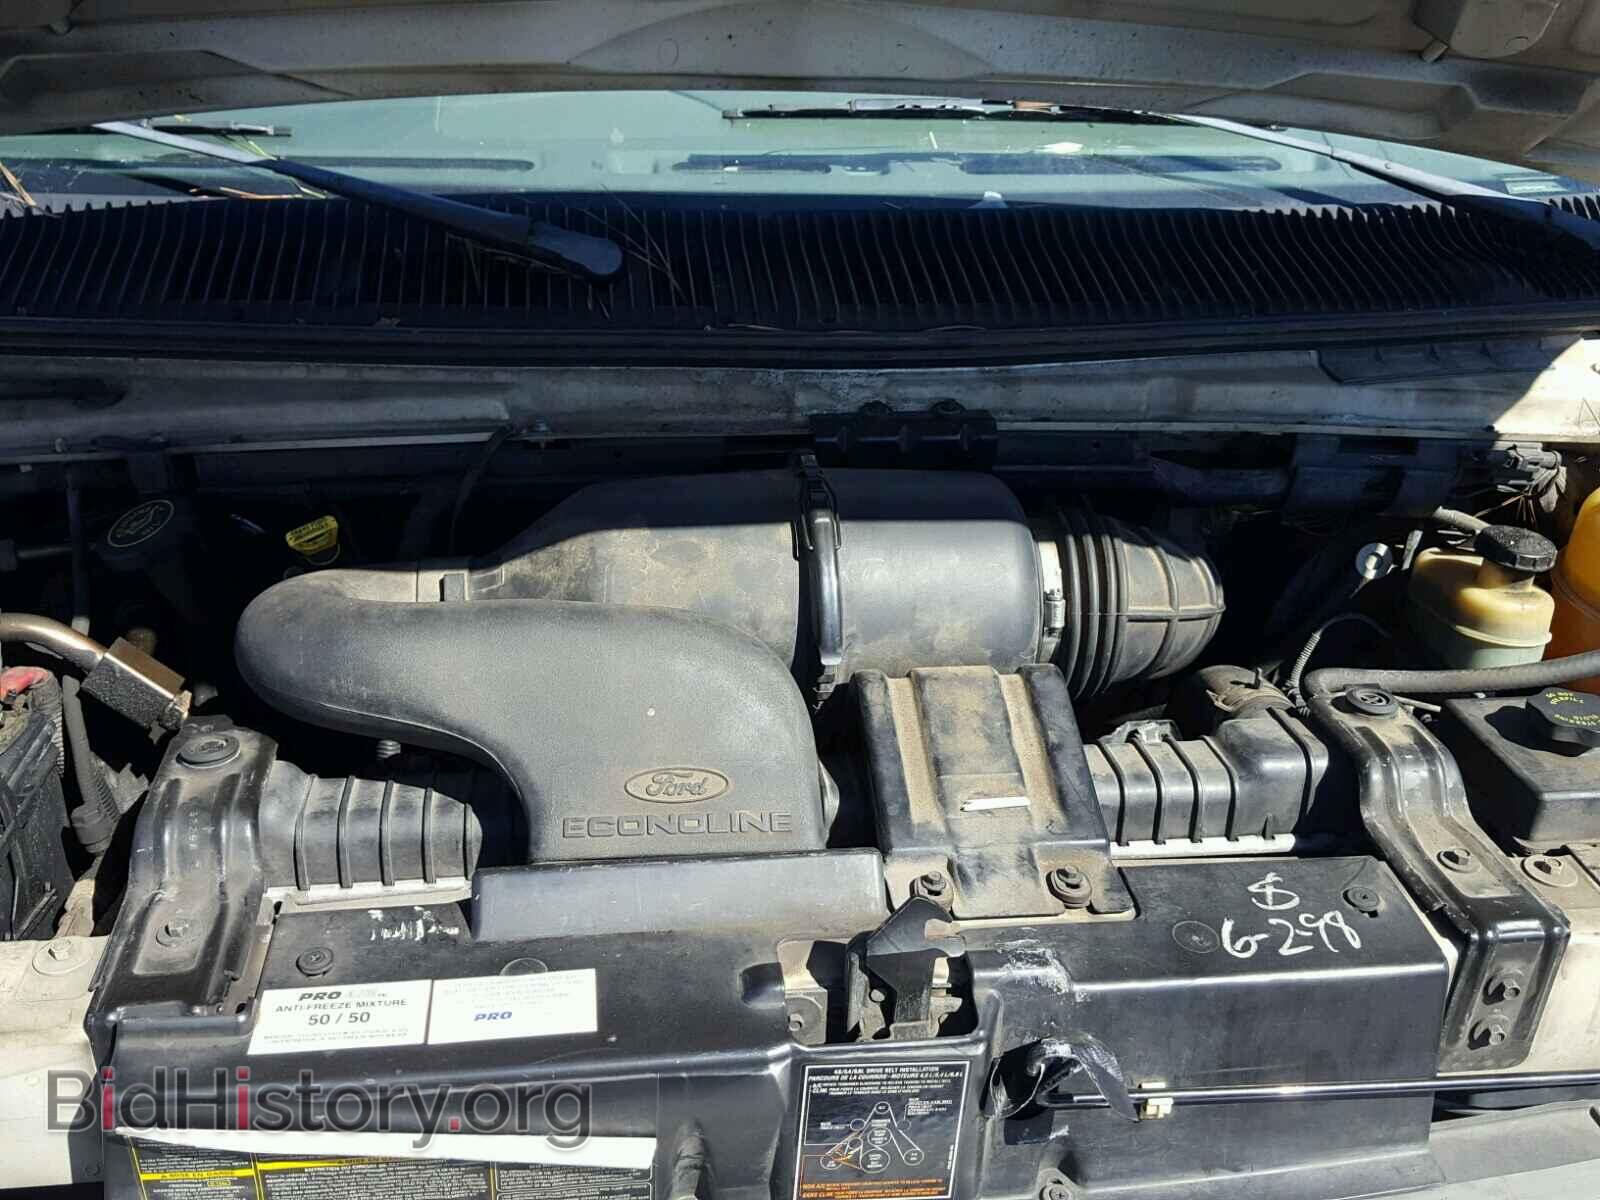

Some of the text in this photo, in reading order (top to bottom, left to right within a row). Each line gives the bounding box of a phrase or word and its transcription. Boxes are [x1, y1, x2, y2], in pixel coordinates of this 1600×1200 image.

[645, 772, 709, 797] Ford
[562, 810, 793, 839] ECONOLINE
[298, 990, 342, 1002] PRO
[355, 998, 408, 1010] MIXTURE
[308, 1013, 331, 1027] 50
[348, 1011, 371, 1025] 50
[473, 1010, 513, 1022] PRO
